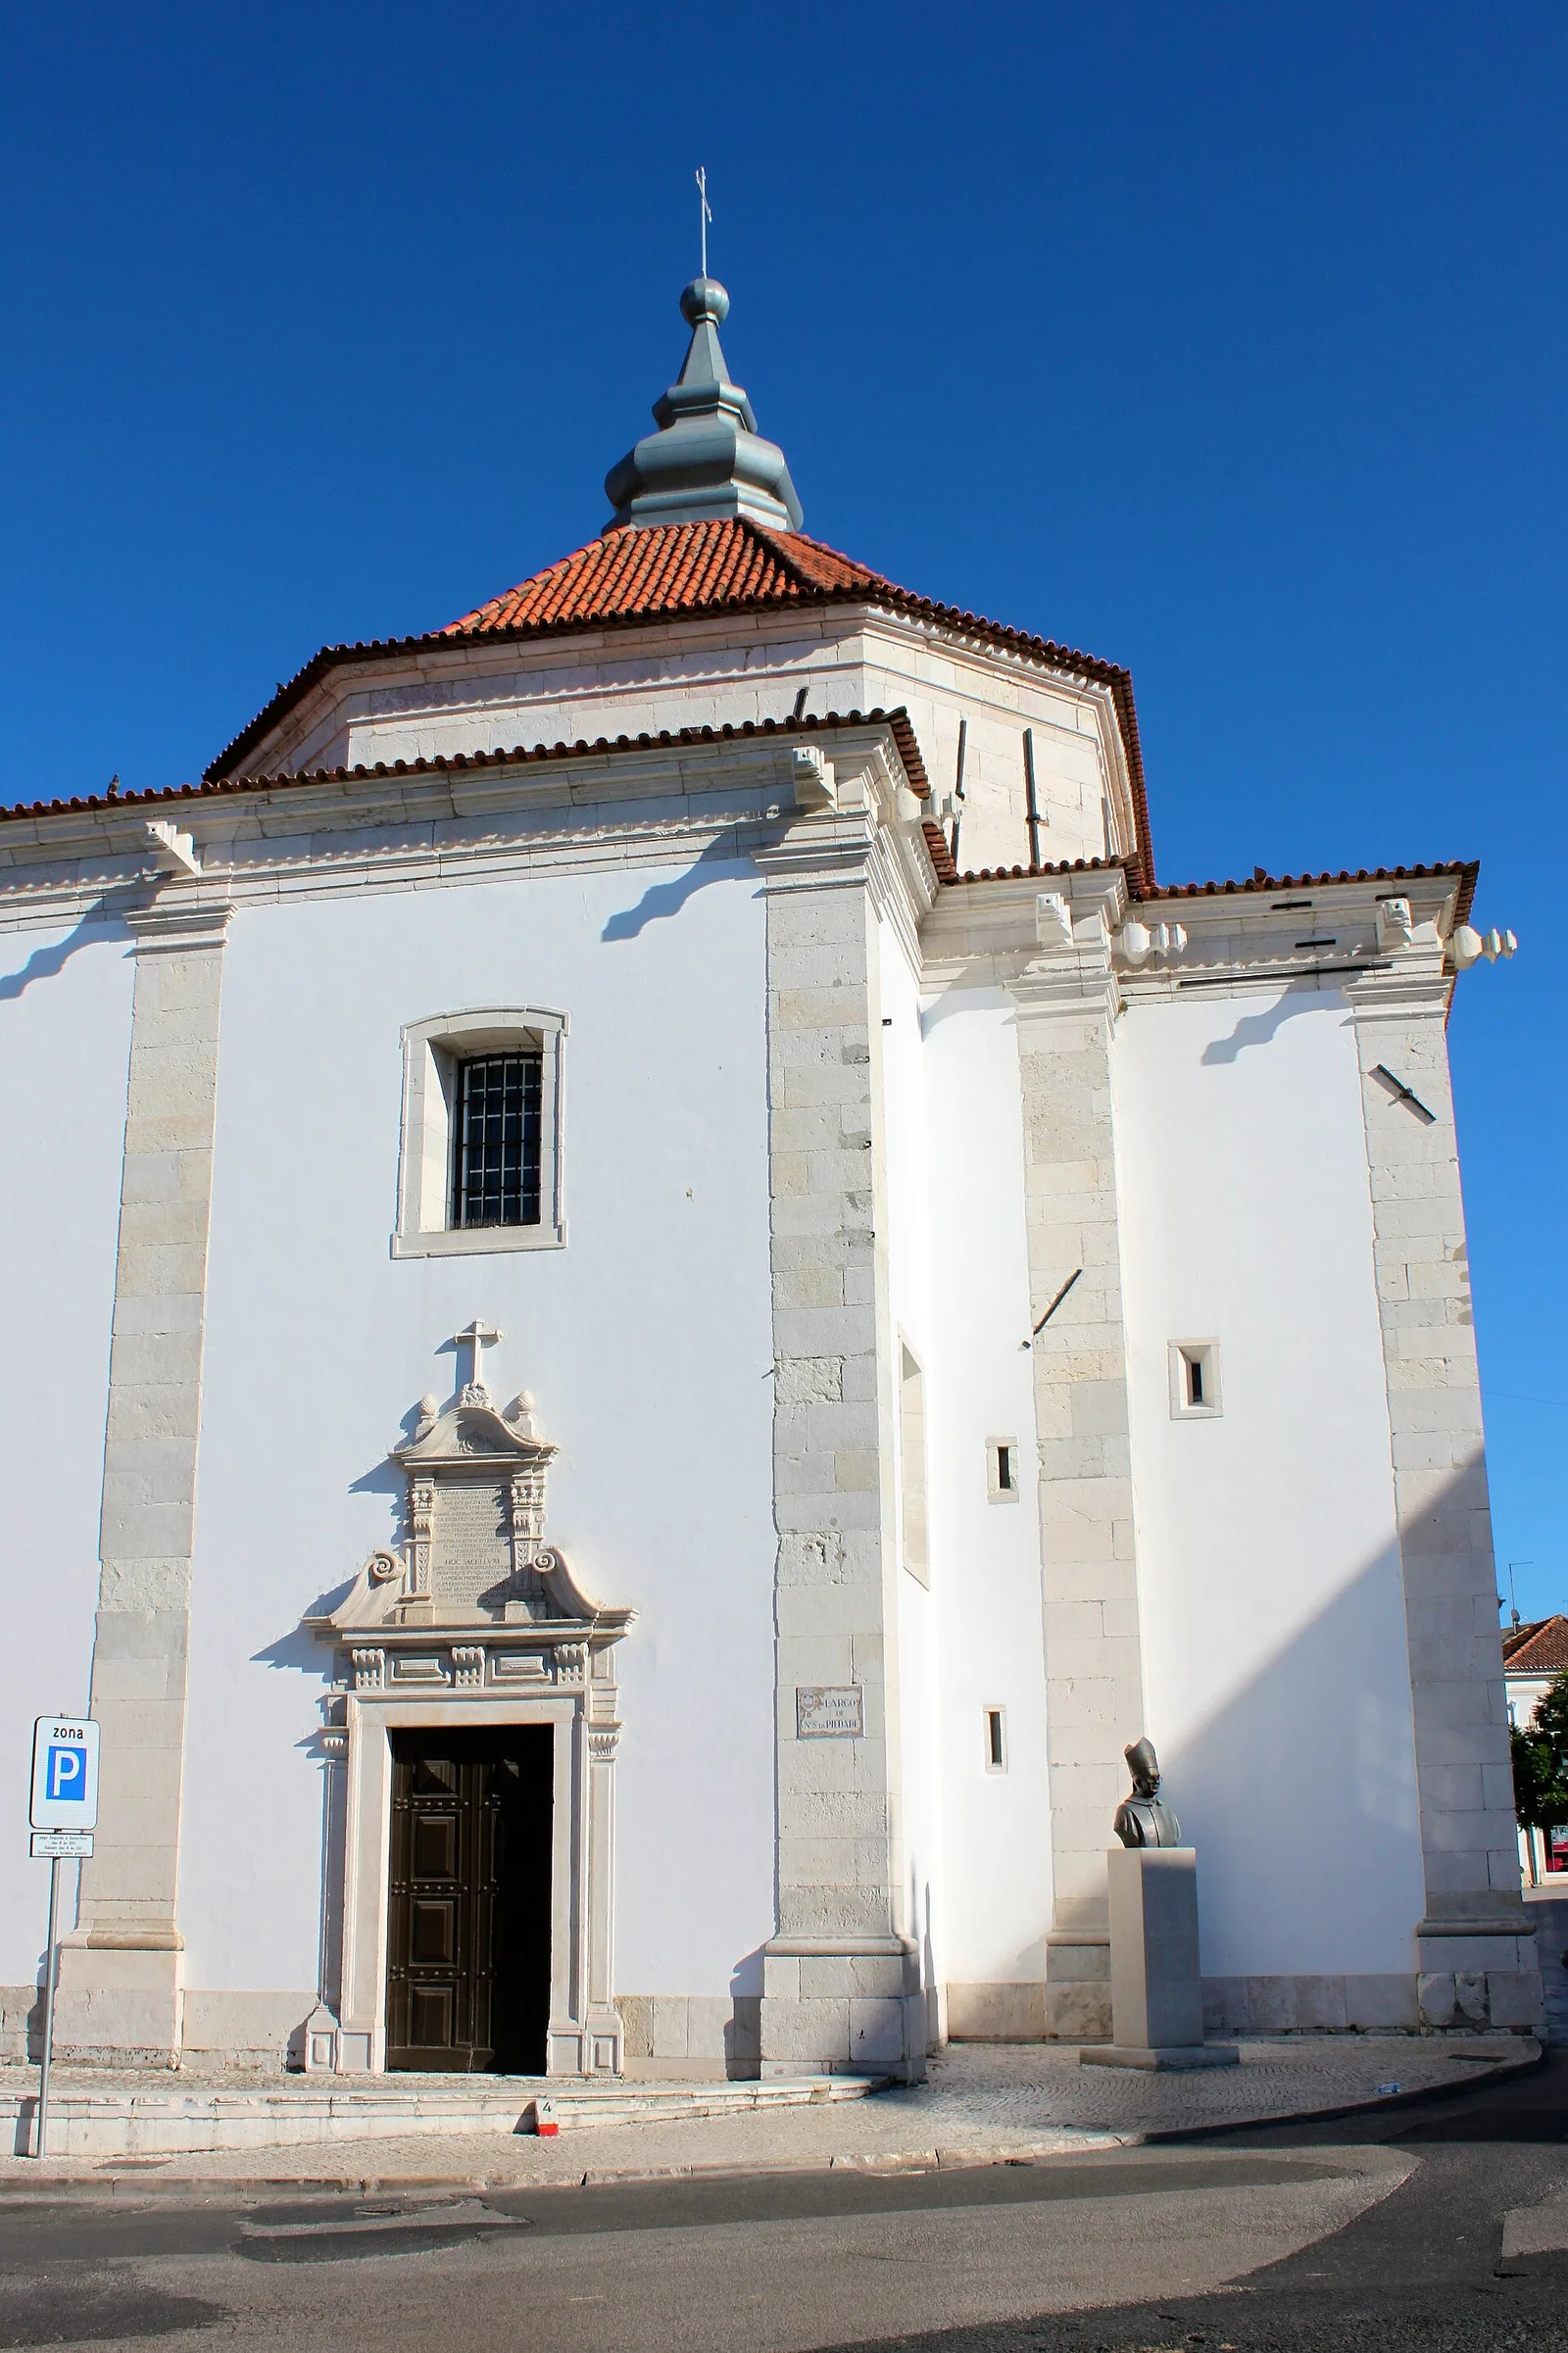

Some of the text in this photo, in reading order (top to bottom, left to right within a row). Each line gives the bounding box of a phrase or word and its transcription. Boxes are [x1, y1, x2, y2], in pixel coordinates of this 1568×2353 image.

[824, 1698, 856, 1707] LARGO
[826, 1720, 858, 1729] PIEDADE
[53, 1727, 84, 1740] zona
[53, 1750, 80, 1796] P
[542, 2101, 552, 2113] 4
